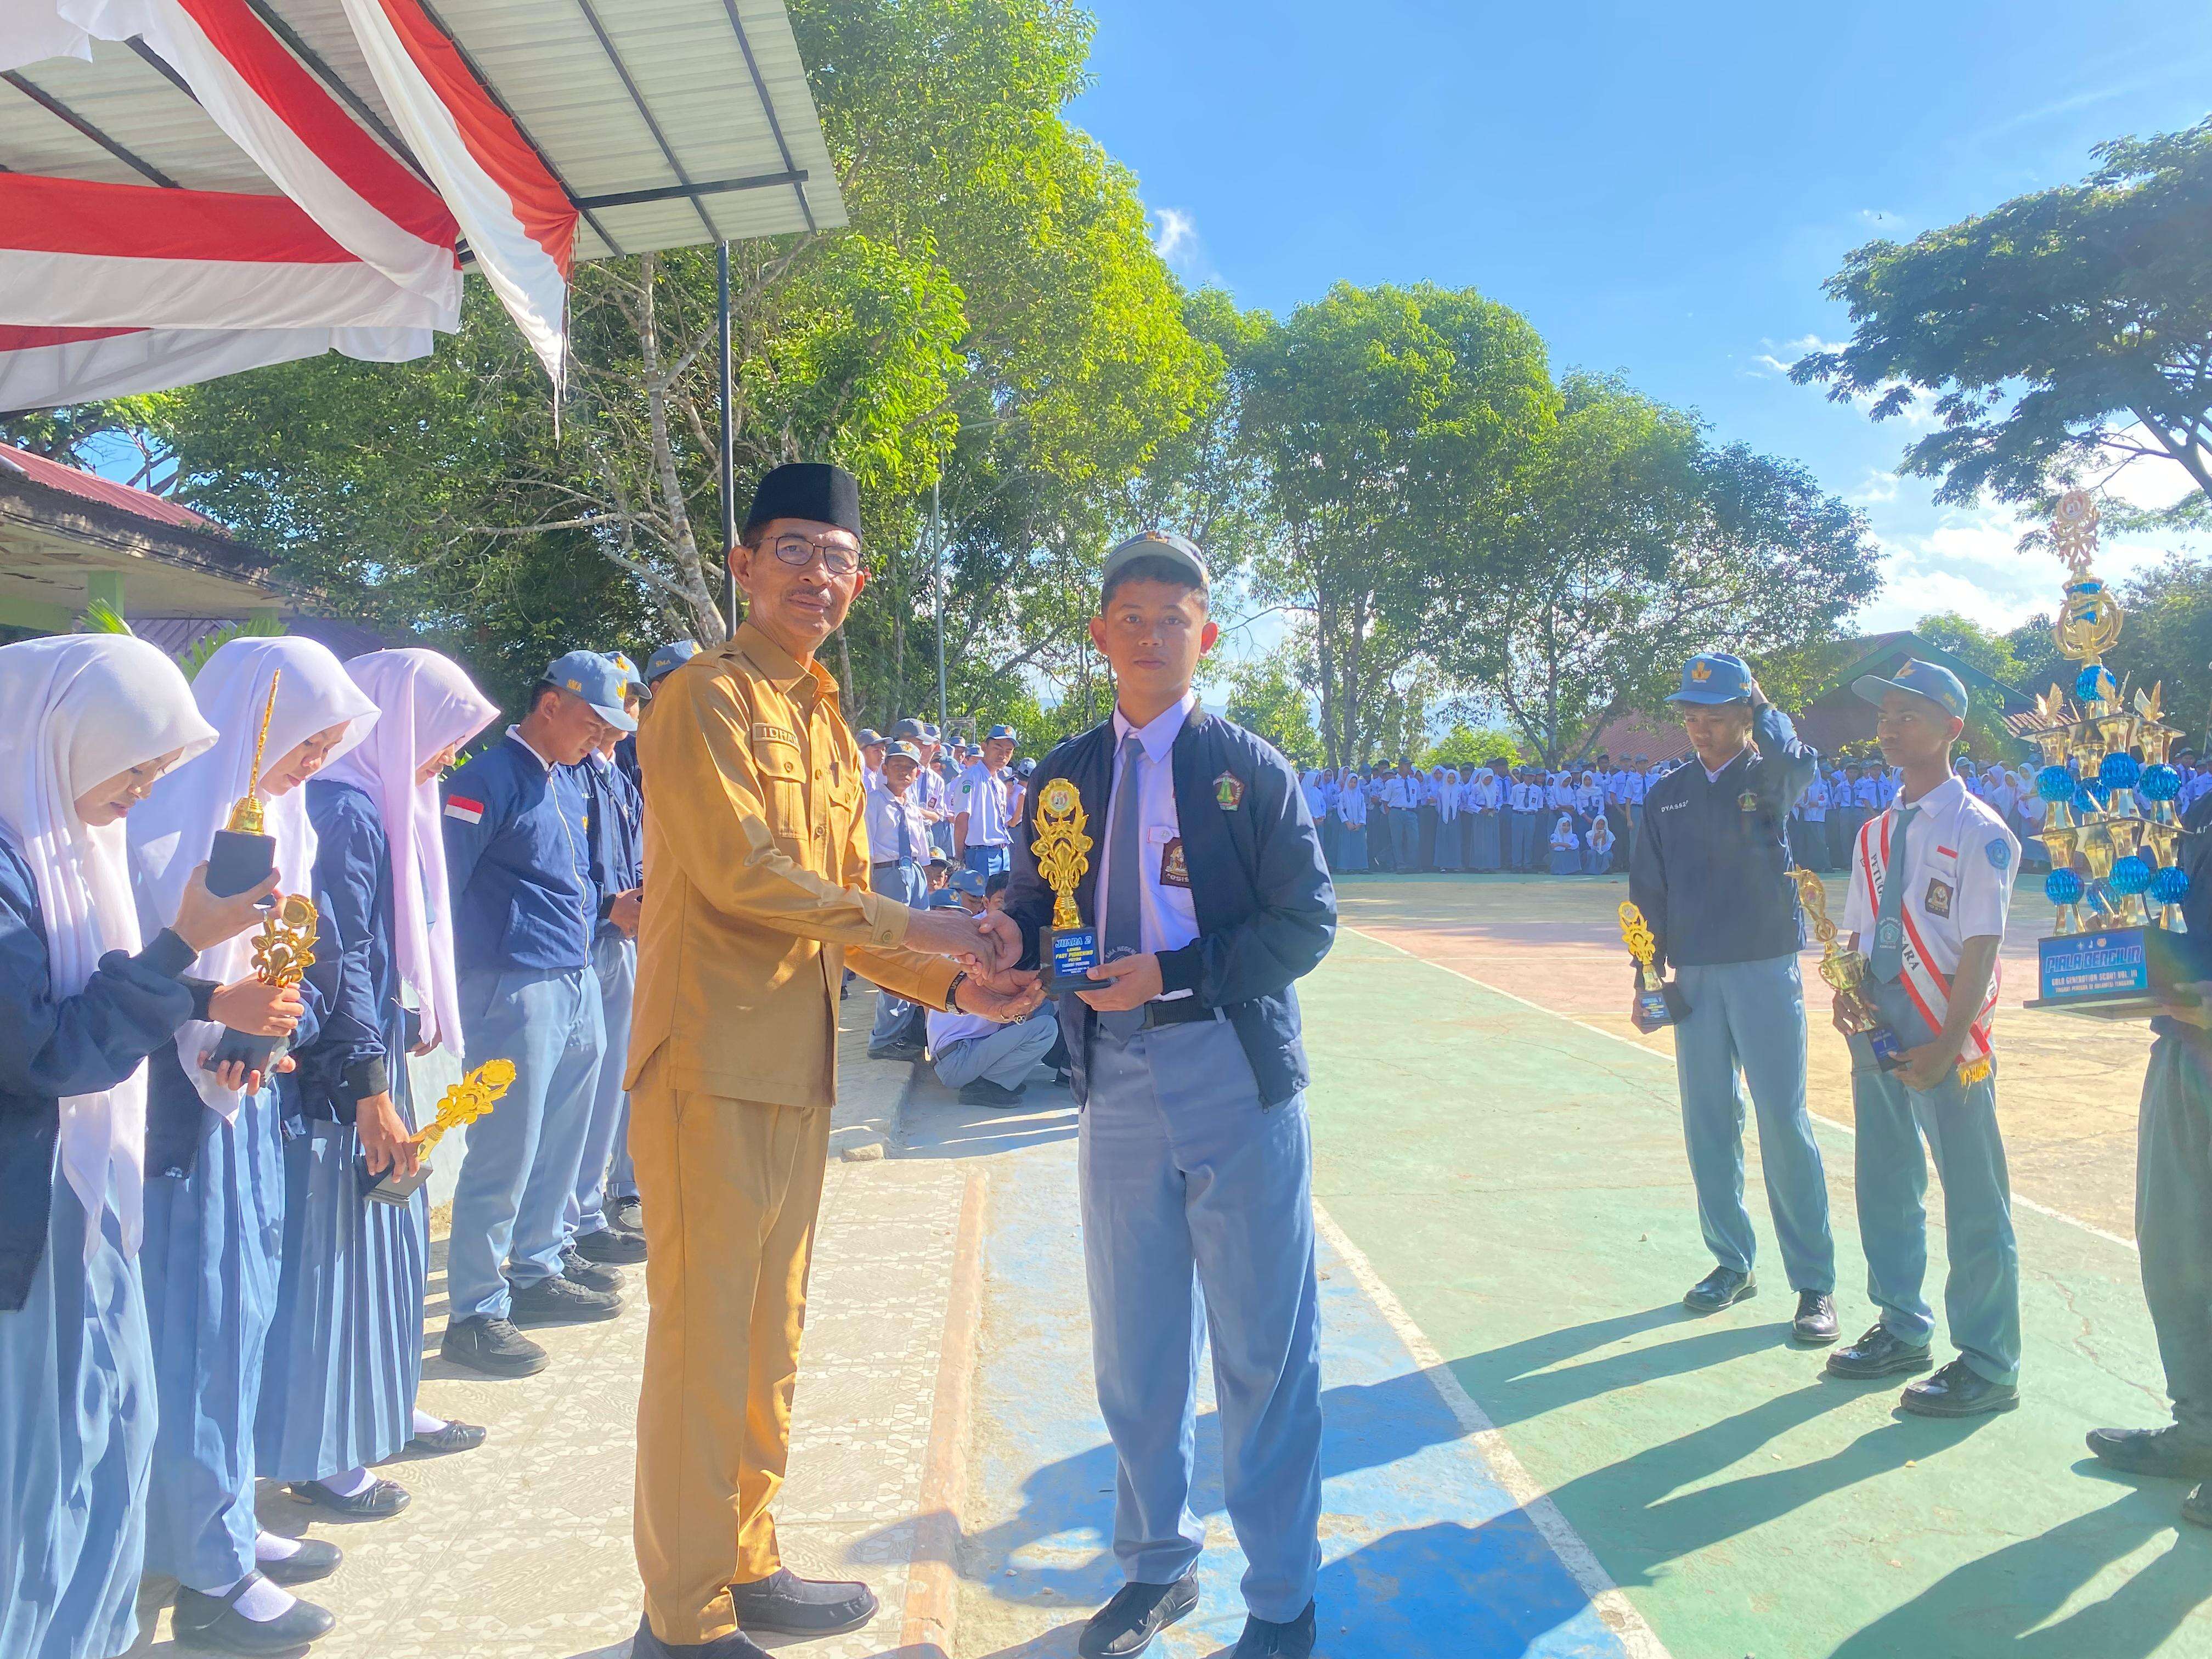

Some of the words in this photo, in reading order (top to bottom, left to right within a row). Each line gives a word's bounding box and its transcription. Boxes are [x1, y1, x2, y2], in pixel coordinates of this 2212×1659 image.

[1055, 937, 1082, 948] JUARA
[1085, 936, 1092, 944] 2
[2045, 953, 2083, 973] PIALA
[2083, 946, 2141, 969] BERGILIR
[2099, 972, 2116, 981] SCOUT
